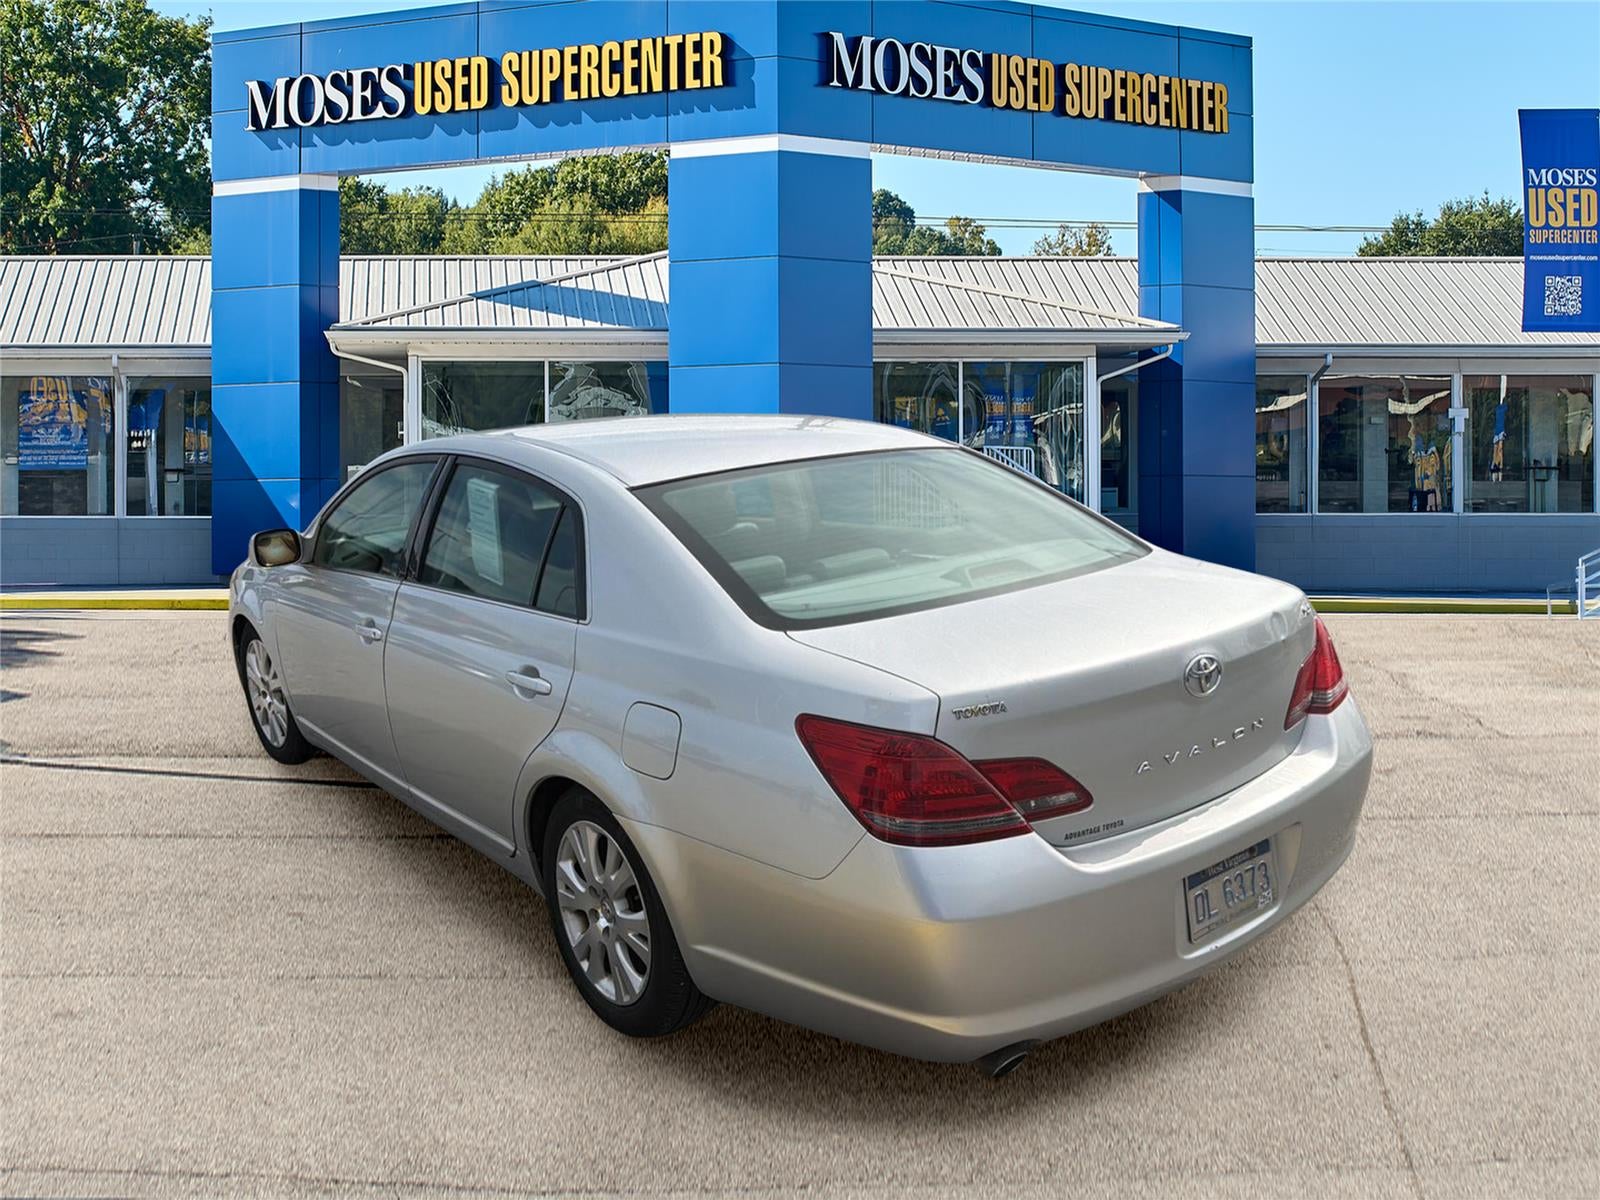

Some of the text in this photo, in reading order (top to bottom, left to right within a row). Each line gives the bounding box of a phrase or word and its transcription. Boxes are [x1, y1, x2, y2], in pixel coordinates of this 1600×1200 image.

[244, 31, 725, 132] MOSES USED SUPERCENTER
[828, 31, 1230, 135] MOSES USED SUPERCENTER
[1527, 167, 1597, 187] MOSES
[1528, 187, 1598, 228] USED
[1529, 229, 1598, 244] SUPERCENTER
[952, 701, 1008, 720] TOYOTA
[1137, 717, 1264, 775] AVALON
[1063, 819, 1125, 841] ADVANTAGE TOYOTA
[1223, 860, 1270, 909] 6373
